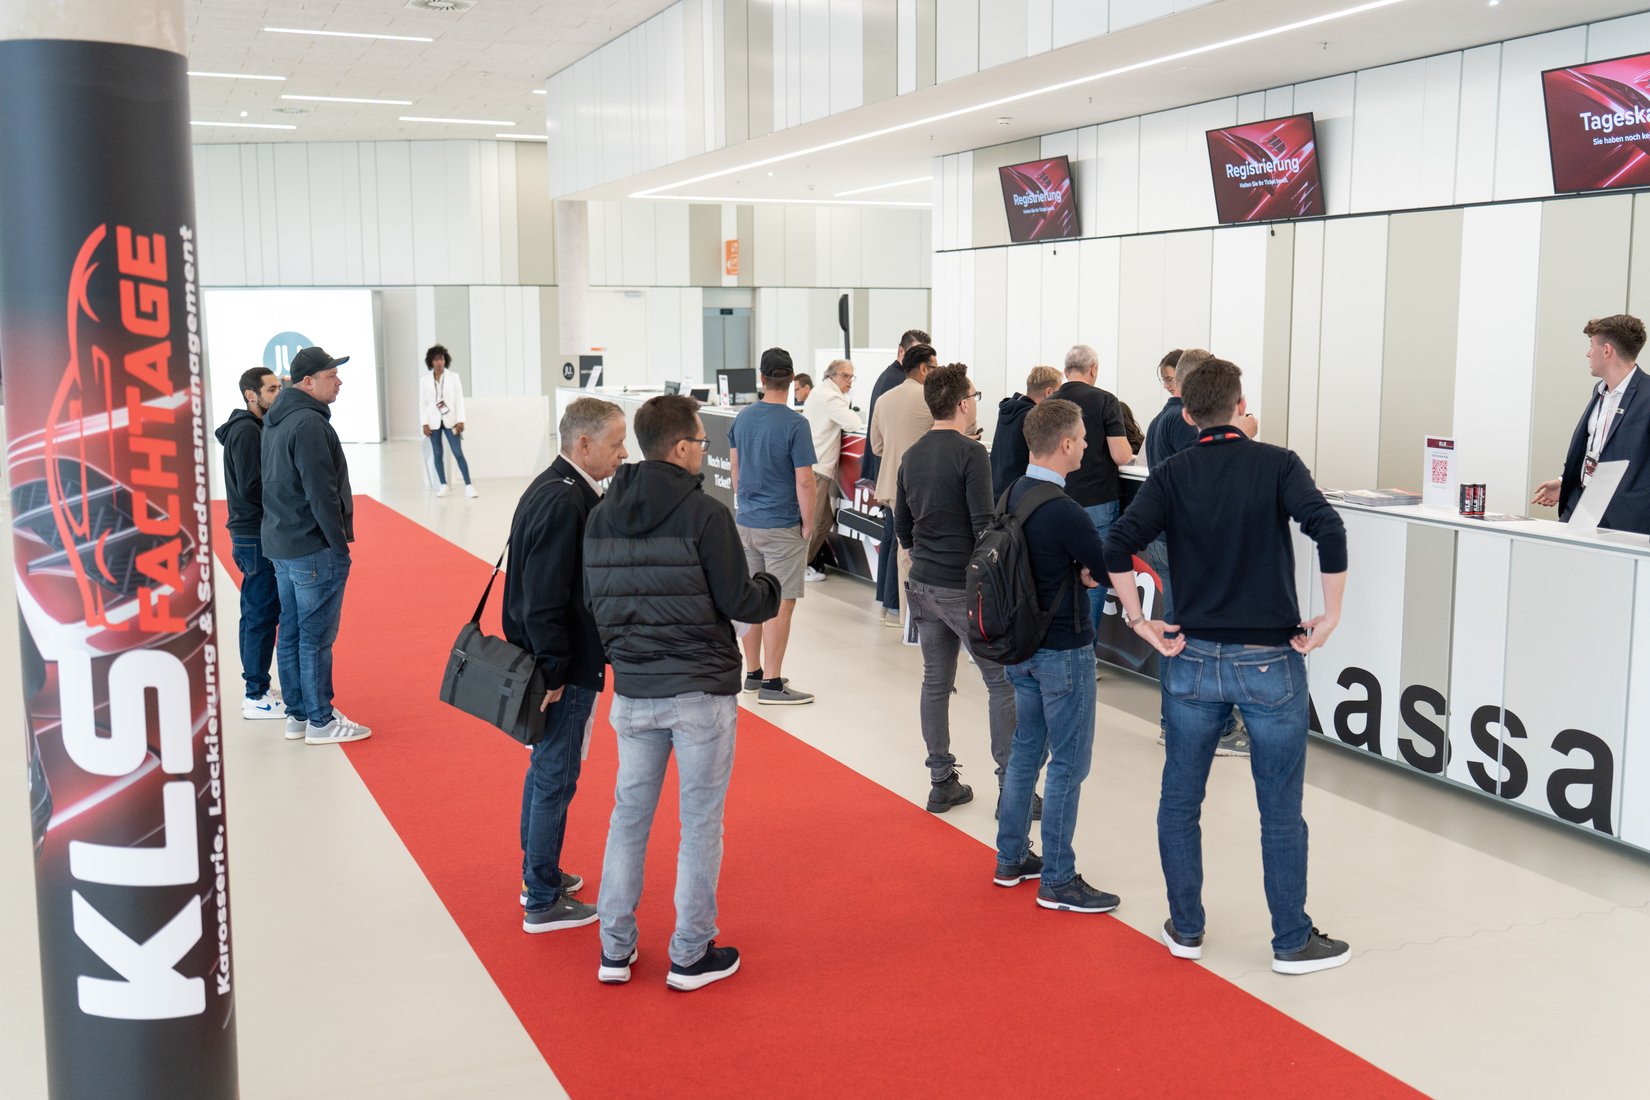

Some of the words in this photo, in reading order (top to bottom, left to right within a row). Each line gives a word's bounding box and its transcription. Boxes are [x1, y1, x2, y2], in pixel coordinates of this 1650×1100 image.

[1604, 135, 1624, 144] haben
[1625, 133, 1640, 142] noch
[1225, 157, 1299, 179] Registrierung
[1013, 190, 1062, 207] Registrierung
[179, 225, 211, 602] Schadensmanagement
[116, 225, 188, 633] FACHTAGE
[707, 454, 721, 468] Noch
[714, 473, 732, 490] Ticket?
[199, 611, 213, 635] &
[204, 644, 222, 816] Lackierung
[1309, 667, 1614, 836] assa
[58, 648, 206, 1020] KLS
